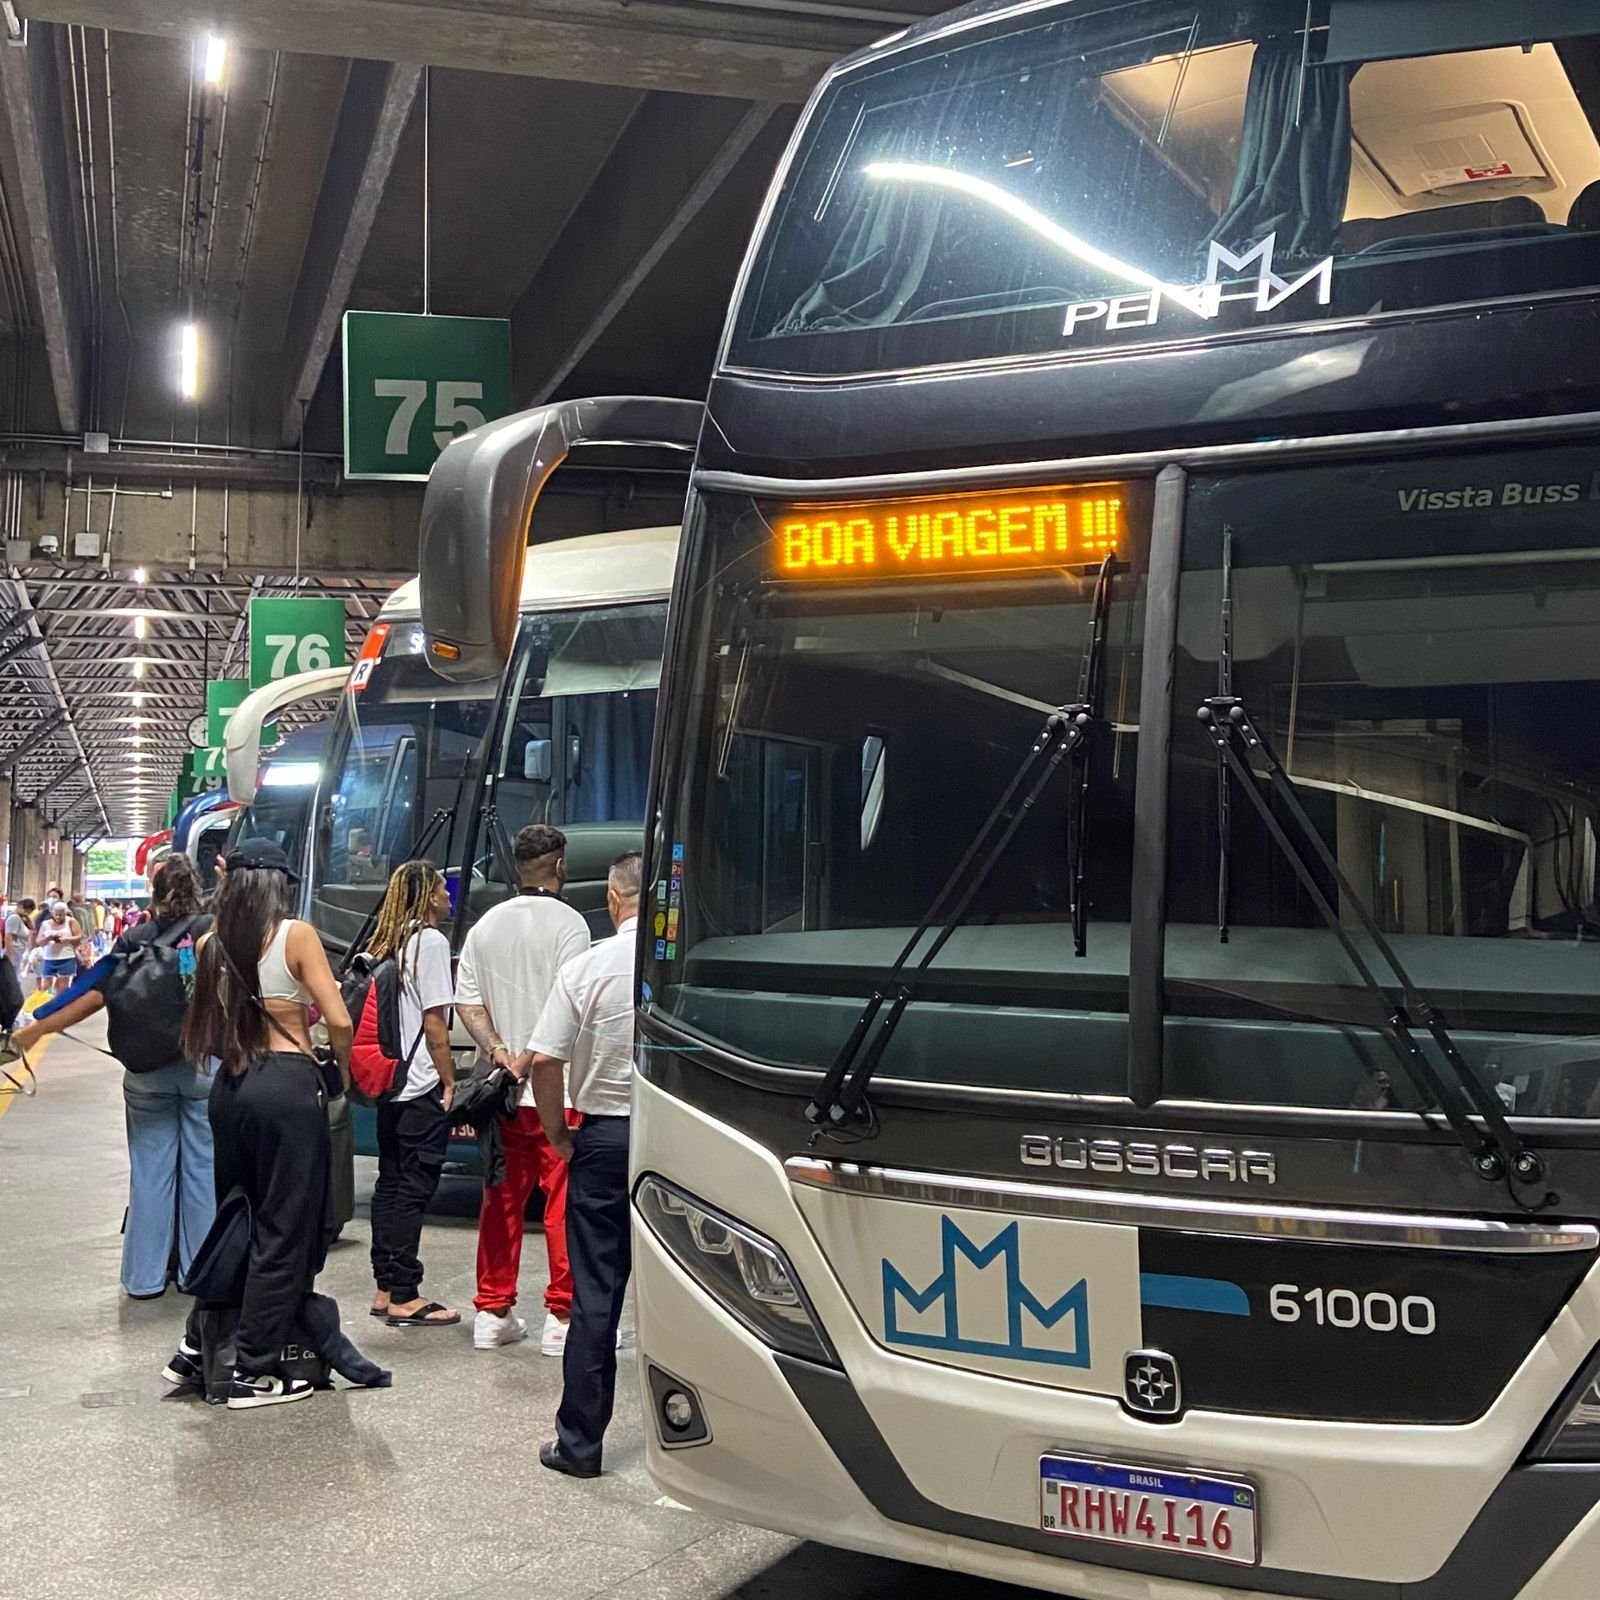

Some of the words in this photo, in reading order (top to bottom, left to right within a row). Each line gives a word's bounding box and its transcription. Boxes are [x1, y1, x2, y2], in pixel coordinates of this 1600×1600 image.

[375, 379, 487, 454] 75
[1398, 486, 1493, 511] Vissta
[1502, 483, 1580, 505] Buss
[784, 518, 873, 568] BOA
[887, 503, 1067, 560] VIAGEM
[265, 634, 331, 678] 76
[1020, 1135, 1276, 1184] BUSSCAR
[1270, 1283, 1436, 1335] 61000
[1129, 1473, 1164, 1488] BRASIL
[1044, 1515, 1056, 1529] BR
[1059, 1483, 1233, 1551] RHW4I16
